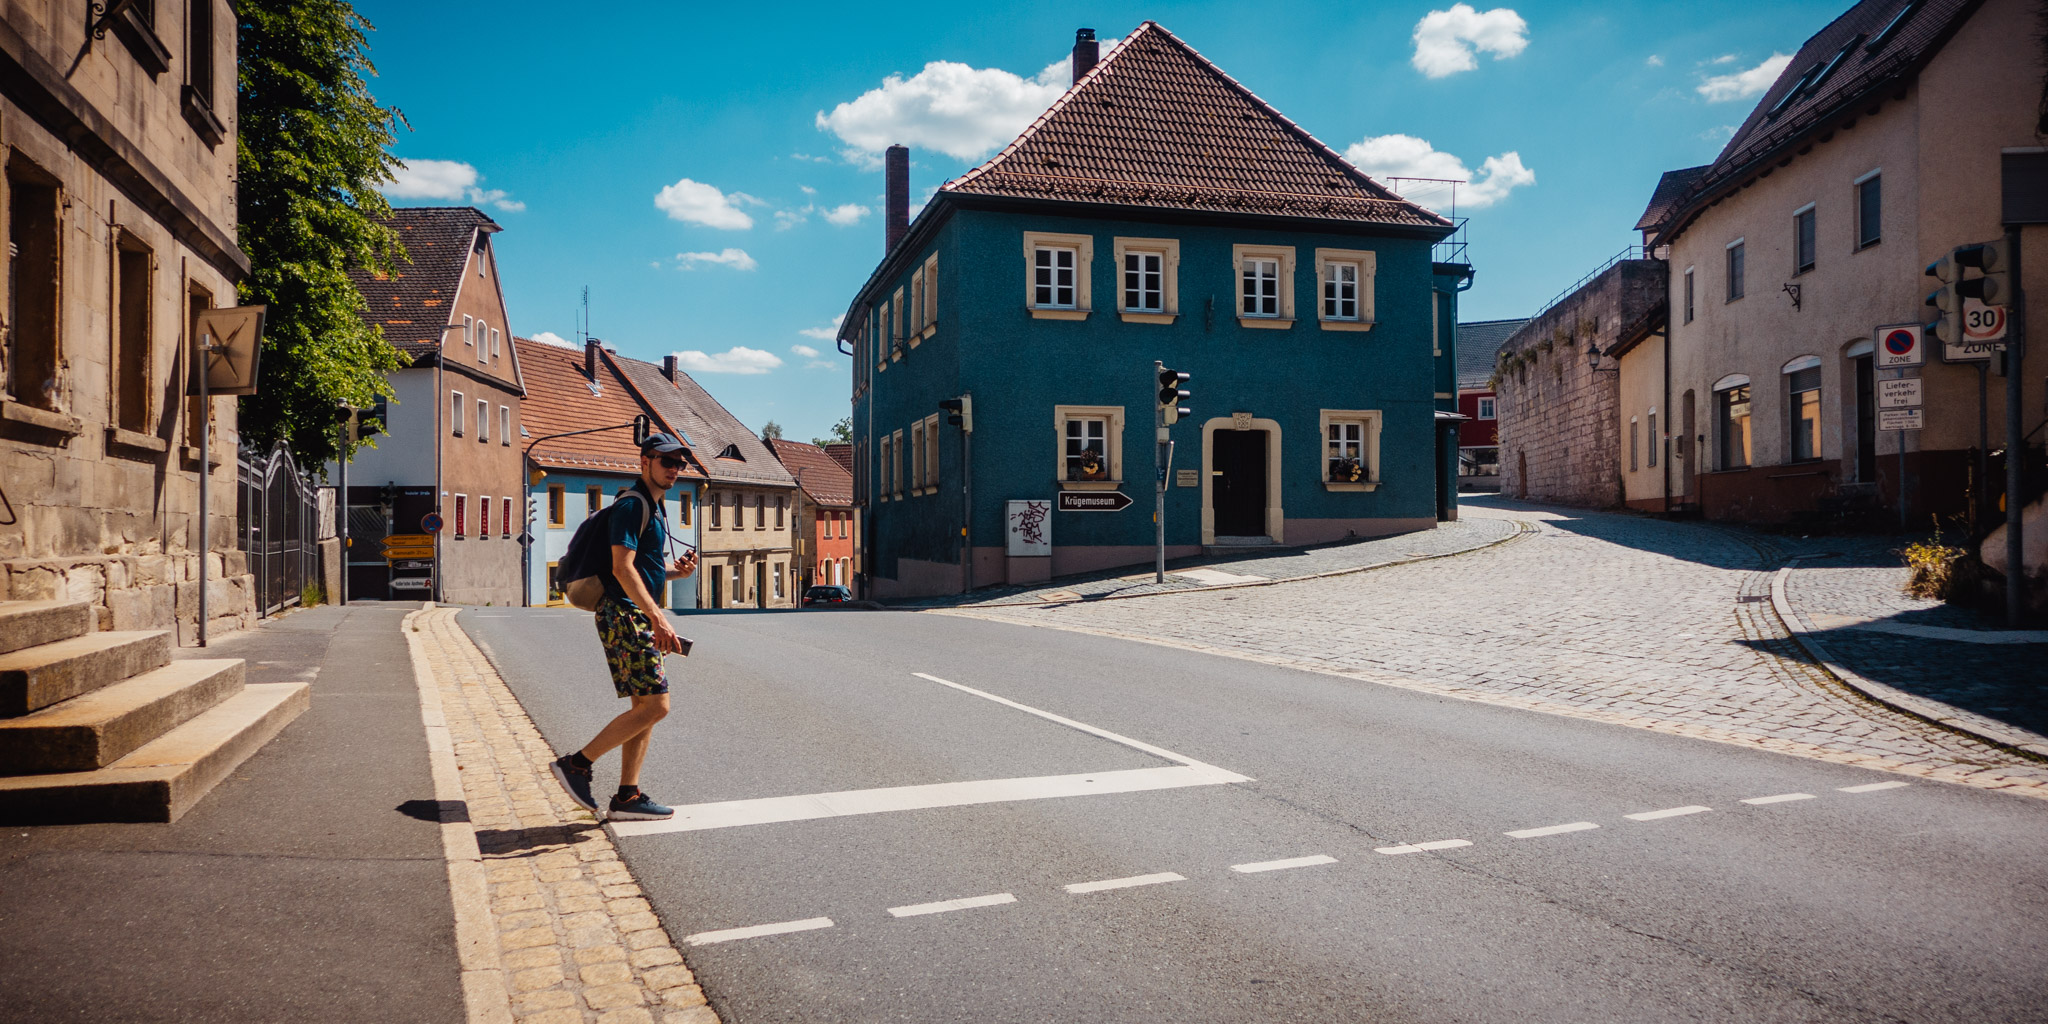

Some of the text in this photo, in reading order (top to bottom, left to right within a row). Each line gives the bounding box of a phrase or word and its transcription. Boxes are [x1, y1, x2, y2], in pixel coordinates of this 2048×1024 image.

[1969, 310, 1995, 328] 30
[1963, 344, 2001, 354] ZONE
[1889, 355, 1911, 363] ZONE
[1886, 382, 1914, 390] Liefer-
[1065, 495, 1115, 508] Krügemuseum
